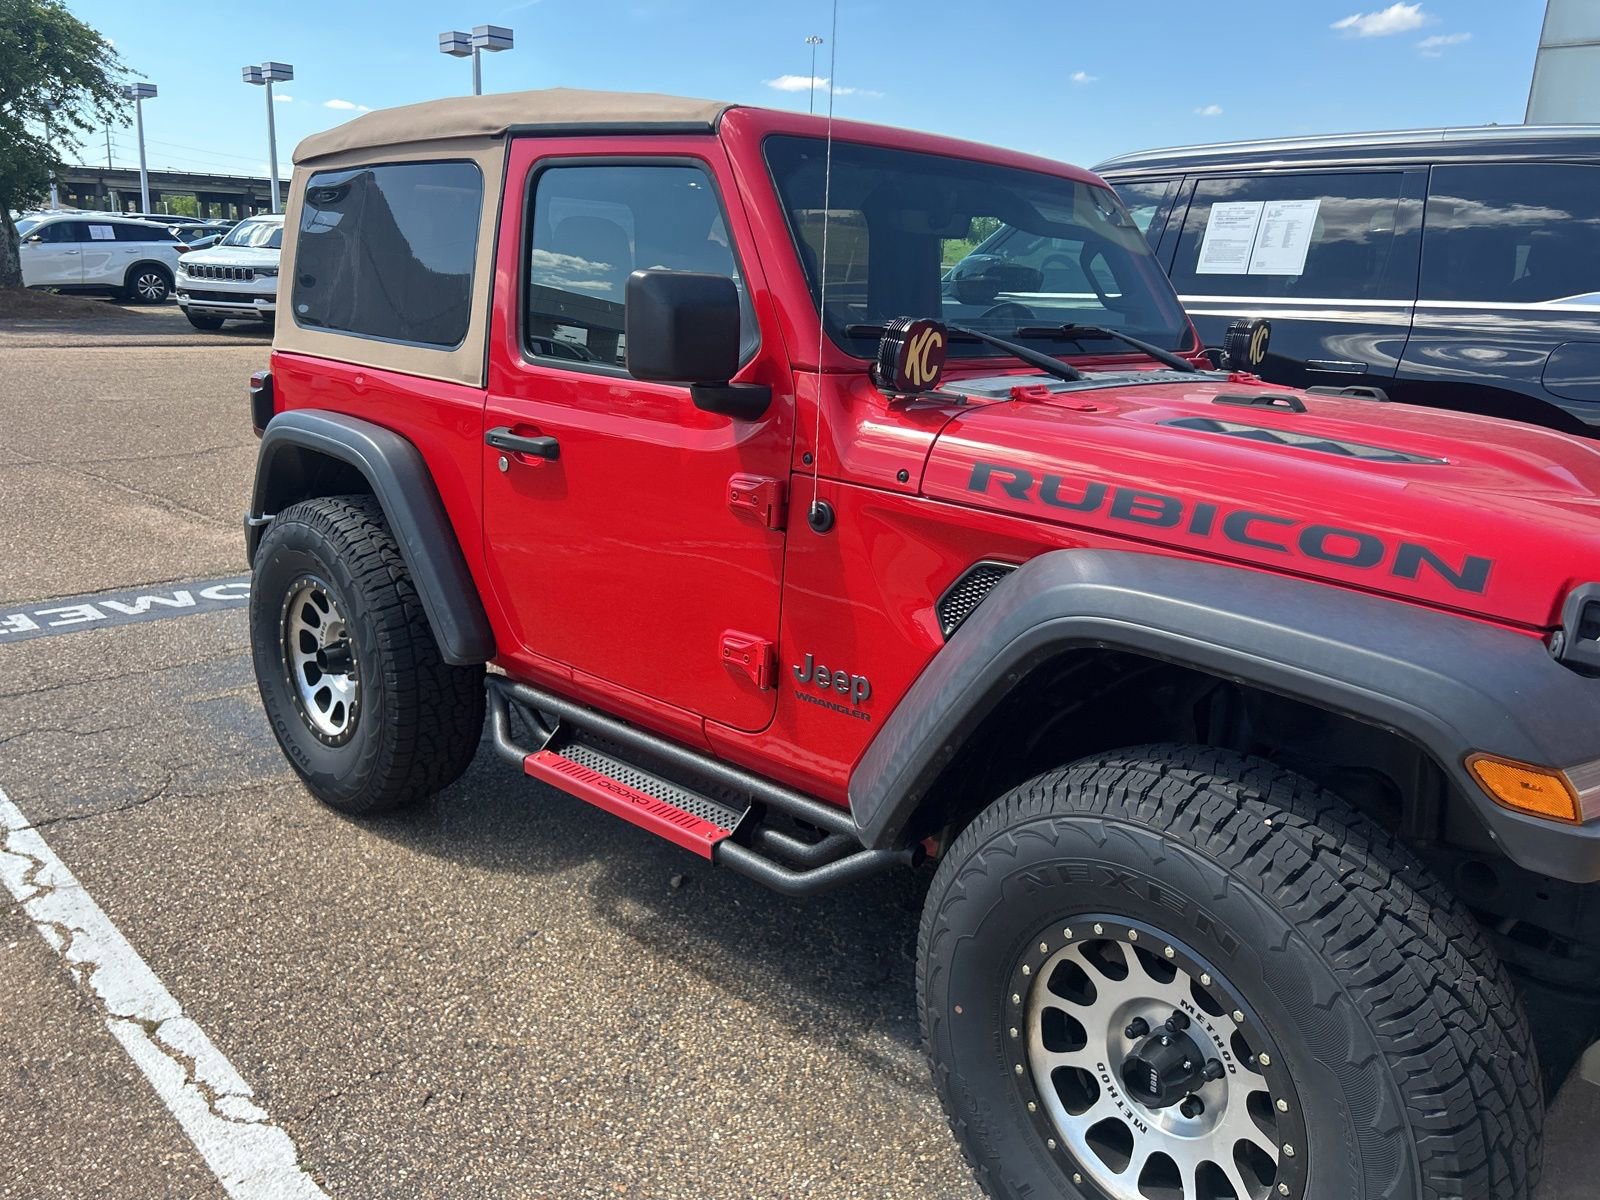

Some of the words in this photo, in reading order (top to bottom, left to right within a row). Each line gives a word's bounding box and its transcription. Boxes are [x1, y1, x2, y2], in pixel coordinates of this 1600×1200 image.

[904, 327, 942, 386] KC
[1249, 325, 1269, 365] KC
[967, 462, 1493, 593] RUBICON
[793, 653, 871, 704] Jeep
[795, 690, 871, 722] WRANGLER
[1016, 863, 1241, 958] NEXEN
[1180, 999, 1236, 1074] METHOD
[1097, 1062, 1148, 1134] METHOD
